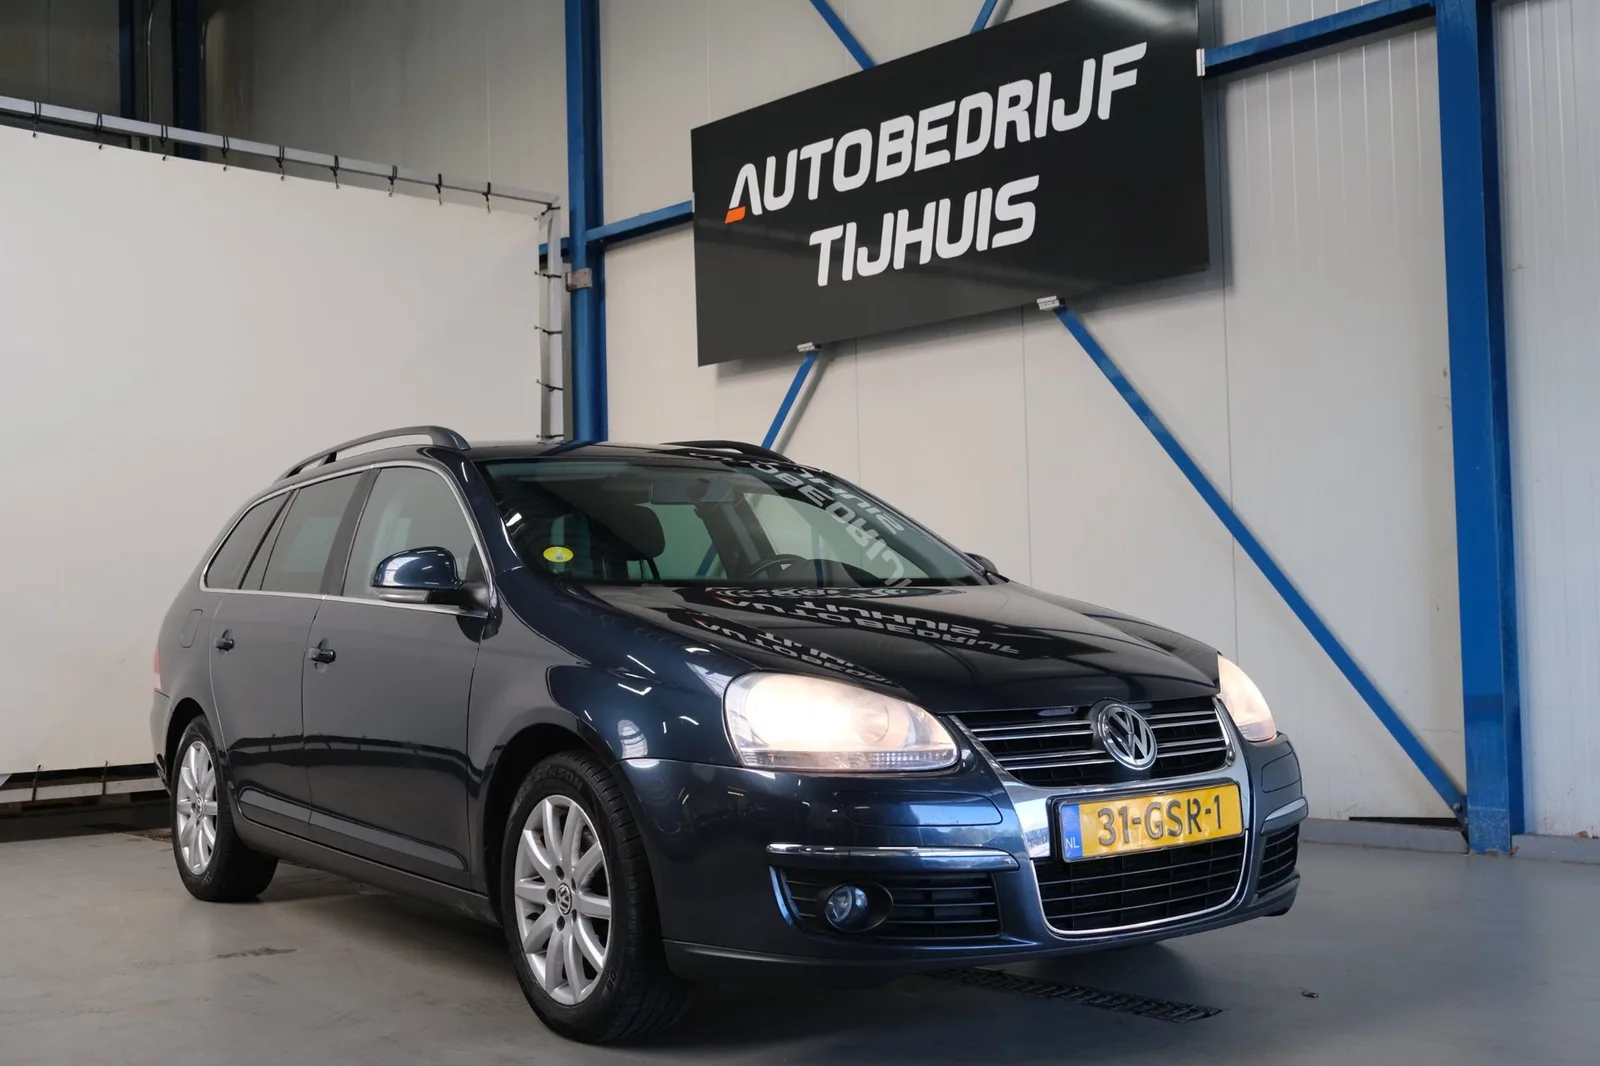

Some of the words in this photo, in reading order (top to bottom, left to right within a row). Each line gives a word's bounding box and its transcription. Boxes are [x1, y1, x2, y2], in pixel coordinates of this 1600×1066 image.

[724, 41, 1147, 224] AUTOBEDRIJF
[809, 174, 1039, 287] TIJHUIS
[1064, 837, 1080, 849] NL
[1097, 795, 1222, 847] 31-GSR-1
